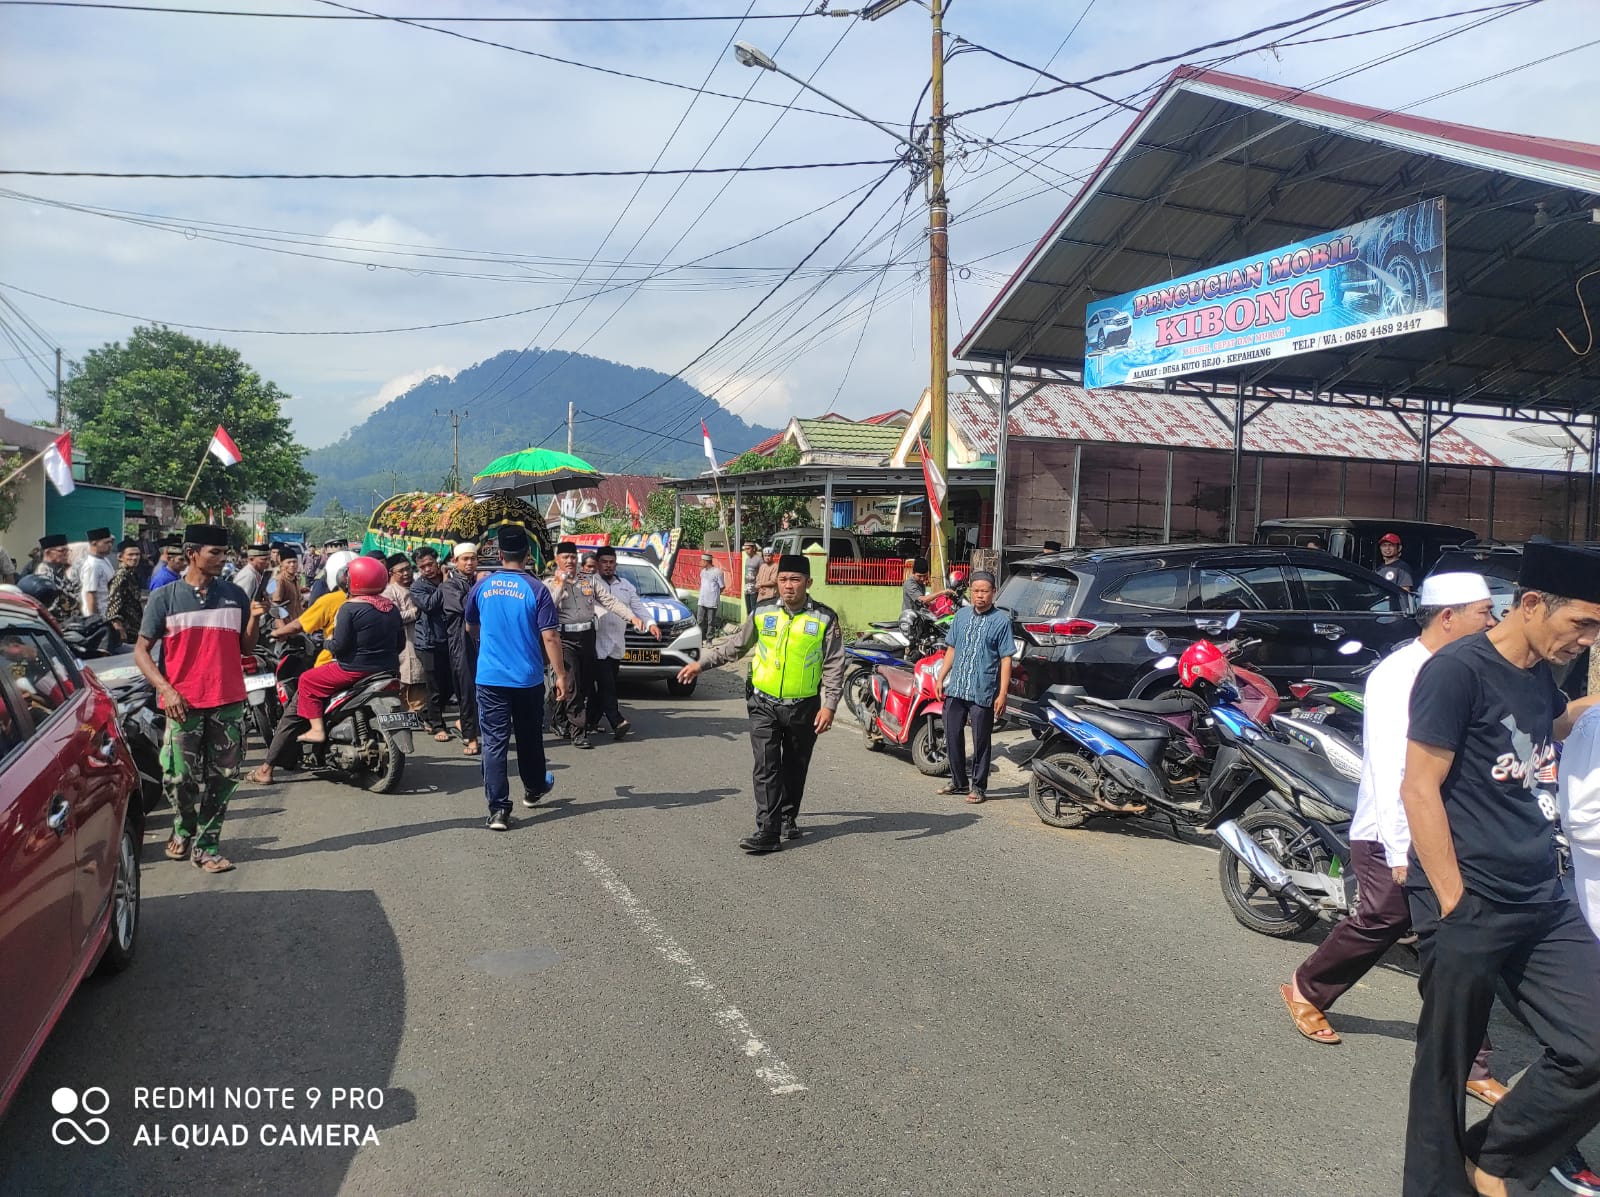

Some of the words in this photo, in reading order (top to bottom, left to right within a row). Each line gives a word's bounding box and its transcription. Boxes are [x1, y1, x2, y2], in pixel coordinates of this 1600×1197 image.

[1133, 261, 1264, 318] PENCUCIAN
[1268, 236, 1360, 283] MOBIL
[1155, 279, 1324, 347] KIBONG
[1236, 336, 1253, 346] DAN
[1292, 338, 1316, 351] TELP
[1323, 333, 1338, 345] WA
[1344, 328, 1367, 341] 0852
[1370, 323, 1394, 336] 4489
[1396, 318, 1421, 332] 2447
[1133, 367, 1158, 379] ALAMAT
[1162, 363, 1180, 375] DESA
[1181, 360, 1200, 372] KUTO
[1202, 357, 1221, 368] REJO
[1227, 347, 1271, 363] KEPAHIANG
[483, 588, 525, 600] BENGKULU
[491, 580, 519, 588] POLDA
